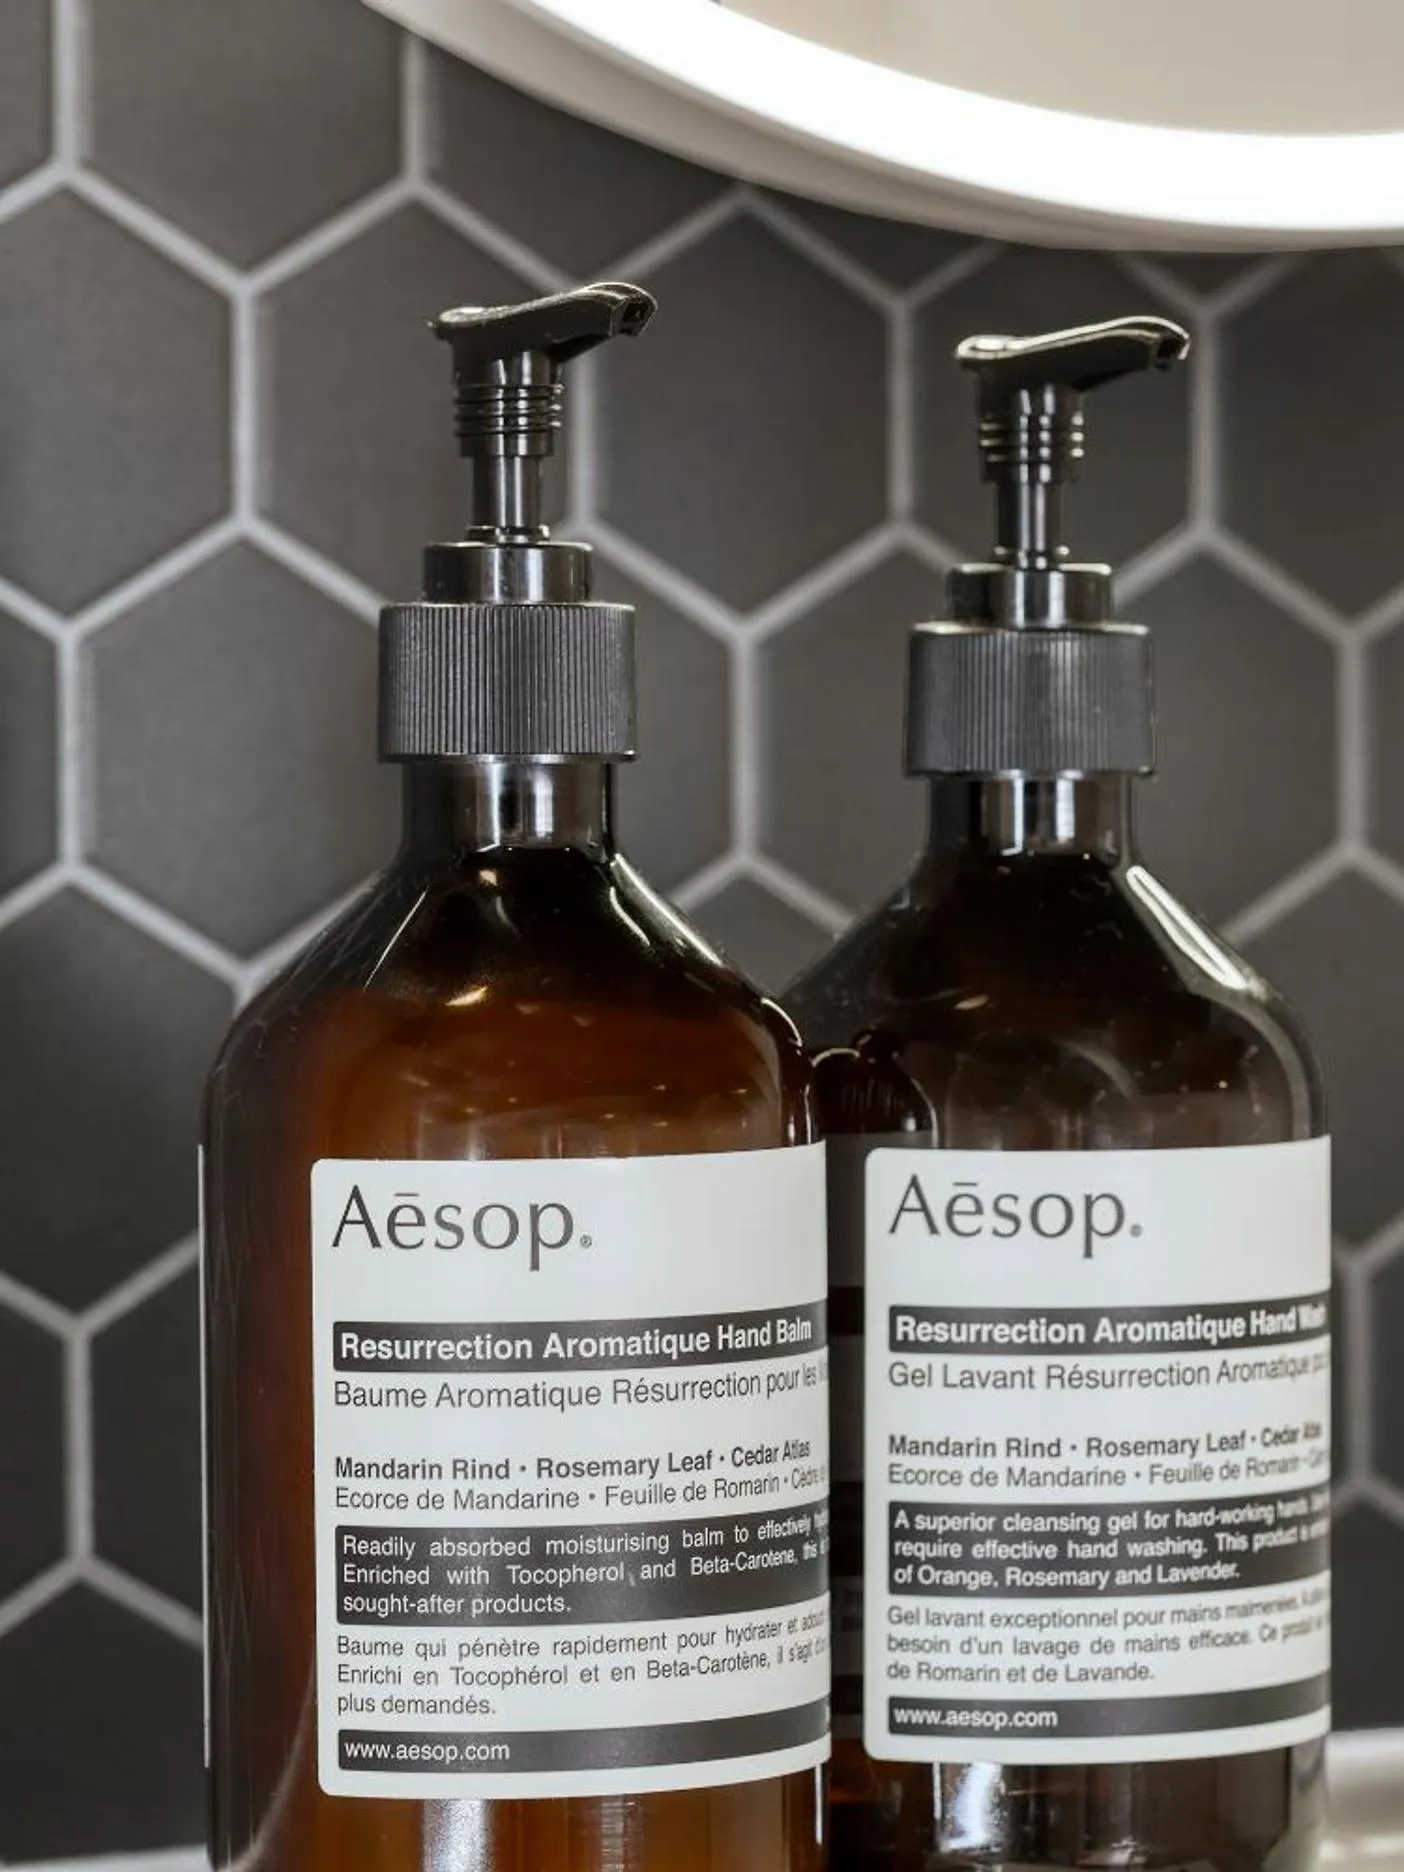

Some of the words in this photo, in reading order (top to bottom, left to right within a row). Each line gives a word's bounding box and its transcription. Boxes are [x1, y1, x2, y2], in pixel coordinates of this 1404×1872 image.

[341, 1332, 533, 1361] Resurrection
[543, 1328, 710, 1369] Aromatique
[717, 1324, 770, 1350] Hand
[776, 1318, 812, 1344] Balm
[895, 1315, 1085, 1344] Resurrection
[1093, 1314, 1245, 1345] Aromatique
[1249, 1311, 1297, 1336] Hand
[888, 1362, 933, 1388] Gel
[942, 1364, 1035, 1389] Lavant
[1046, 1356, 1210, 1389] Résurrection
[1216, 1352, 1310, 1387] Aromatique
[335, 1380, 427, 1407] Baume
[435, 1380, 601, 1418] Aromatique
[612, 1371, 761, 1404] Résurrection
[766, 1369, 800, 1399] pour
[888, 1435, 997, 1457] Mandarin
[1006, 1437, 1062, 1458] Rind
[1086, 1437, 1199, 1459] Rosemary
[1206, 1431, 1246, 1453] Leaf
[1261, 1425, 1300, 1449] Cedar
[335, 1457, 444, 1481] Mandarin
[452, 1458, 510, 1480] Rind
[536, 1454, 660, 1481] Rosemary
[668, 1451, 713, 1474] Leaf
[731, 1444, 780, 1469] Cedar
[783, 1440, 811, 1465] Atlas
[888, 1464, 963, 1487] Ecorce
[970, 1465, 998, 1487] de
[1007, 1465, 1126, 1488] Mandarine
[1150, 1461, 1213, 1484] Feuille
[1219, 1457, 1240, 1480] de
[335, 1488, 409, 1510] Ecorce
[417, 1489, 445, 1510] de
[454, 1488, 580, 1512] Mandarine
[605, 1482, 677, 1506] Feuille
[683, 1480, 706, 1503] de
[714, 1474, 780, 1500] Romarin
[894, 1510, 909, 1529] A
[916, 1513, 995, 1535] superior
[1002, 1512, 1101, 1535] cleansing
[1106, 1512, 1138, 1535] gel
[1144, 1510, 1170, 1530] for
[1175, 1503, 1275, 1528] hard-working
[342, 1535, 415, 1561] Readily
[429, 1536, 531, 1556] absorbed
[545, 1532, 669, 1556] moisturising
[682, 1528, 724, 1549] balm
[734, 1525, 749, 1543] to
[894, 1540, 963, 1561] require
[972, 1539, 1059, 1560] effective
[1067, 1538, 1118, 1560] hand
[1127, 1535, 1208, 1560] washing.
[1215, 1530, 1249, 1552] This
[343, 1564, 430, 1585] Enriched
[446, 1566, 489, 1585] with
[640, 1562, 676, 1580] and
[894, 1565, 913, 1586] of
[917, 1567, 998, 1589] Orange,
[1006, 1567, 1110, 1590] Rosemary
[1115, 1565, 1152, 1585] and
[1157, 1561, 1240, 1584] Lavender.
[342, 1594, 464, 1616] sought-after
[471, 1594, 571, 1617] products.
[888, 1605, 920, 1626] Gel
[926, 1607, 985, 1627] lavant
[990, 1608, 1118, 1631] exceptionnel
[1124, 1608, 1166, 1630] pour
[1171, 1603, 1221, 1625] mains
[337, 1636, 404, 1658] Baume
[415, 1640, 447, 1661] qui
[458, 1637, 540, 1662] pénètre
[552, 1634, 667, 1661] rapidement
[677, 1629, 716, 1652] pour
[725, 1621, 783, 1649] hydrater
[888, 1634, 950, 1655] besoin
[960, 1636, 1003, 1656] d'un
[1014, 1636, 1079, 1658] lavage
[1089, 1637, 1115, 1654] de
[1124, 1633, 1180, 1653] mains
[1188, 1626, 1251, 1652] efficace.
[337, 1664, 402, 1685] Enrichi
[413, 1667, 439, 1685] en
[449, 1665, 568, 1690] Tocophérol
[580, 1666, 599, 1682] et
[610, 1665, 636, 1682] en
[647, 1650, 771, 1678] Beta-Carotène,
[888, 1661, 911, 1680] de
[917, 1663, 1000, 1682] Romarin
[1007, 1665, 1026, 1682] et
[1032, 1664, 1059, 1682] de
[1064, 1661, 1154, 1682] Lavande.
[337, 1693, 376, 1716] plus
[381, 1692, 496, 1716] demandés.
[894, 1706, 1059, 1730] www.aesop.com
[345, 1741, 510, 1764] www.aesop.com
